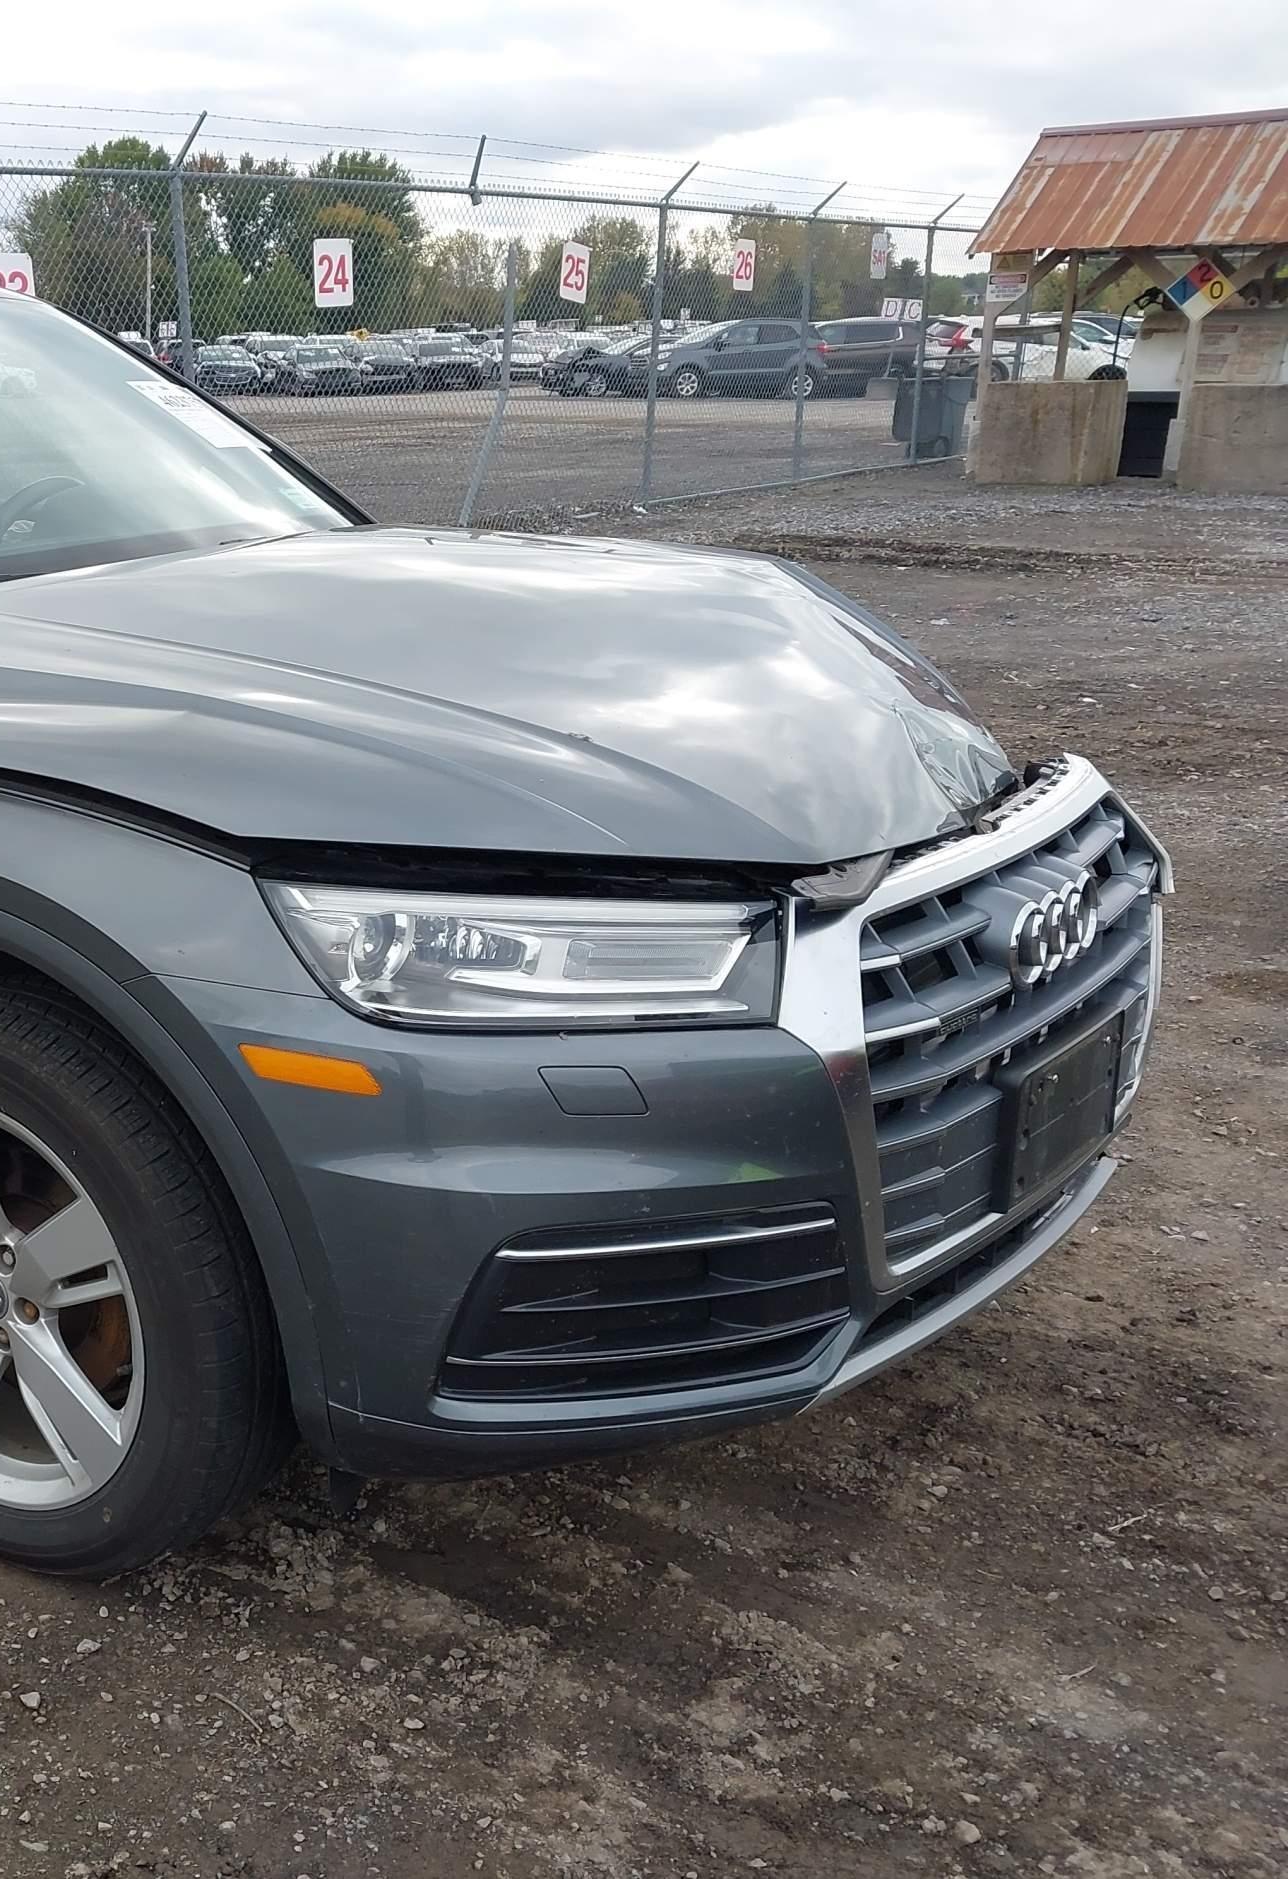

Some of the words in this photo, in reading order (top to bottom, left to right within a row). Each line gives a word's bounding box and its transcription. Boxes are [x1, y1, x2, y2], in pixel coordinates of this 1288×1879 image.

[317, 253, 350, 294] 24
[562, 253, 586, 292] 25
[735, 249, 753, 281] 26
[1197, 263, 1213, 283] 2
[1209, 280, 1224, 300] 0
[884, 300, 899, 318] D
[908, 301, 922, 320] C
